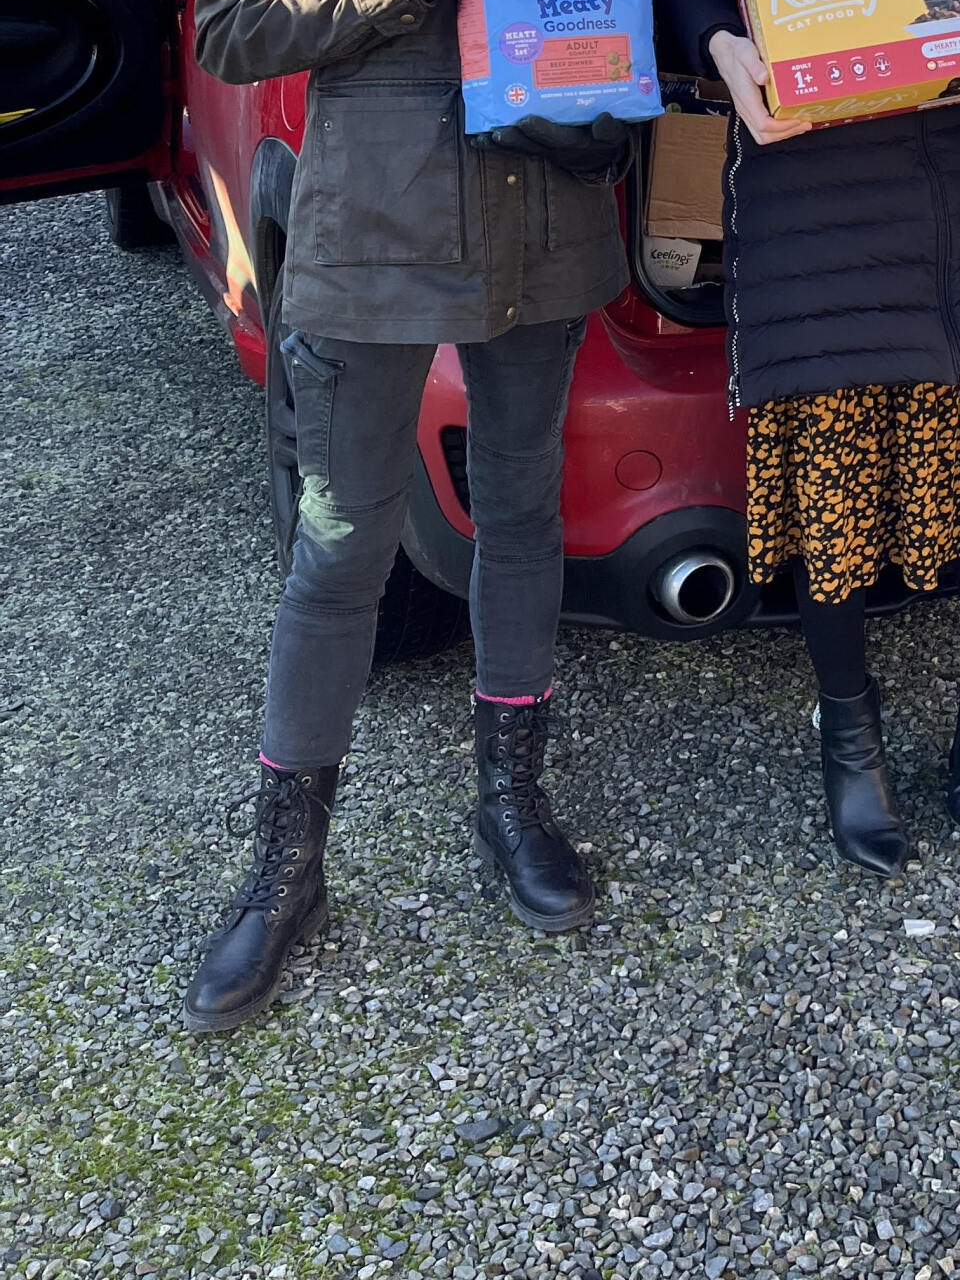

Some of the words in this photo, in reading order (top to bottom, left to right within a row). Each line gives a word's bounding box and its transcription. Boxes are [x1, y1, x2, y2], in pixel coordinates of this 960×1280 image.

[544, 17, 616, 33] Goodness
[787, 19, 815, 32] CAT
[818, 9, 855, 23] FOOD
[505, 30, 537, 40] MEATY
[566, 40, 599, 51] ADULT
[934, 39, 959, 50] MEATY
[791, 62, 812, 71] ADULT
[794, 71, 813, 89] 1+
[794, 86, 818, 95] YEARS
